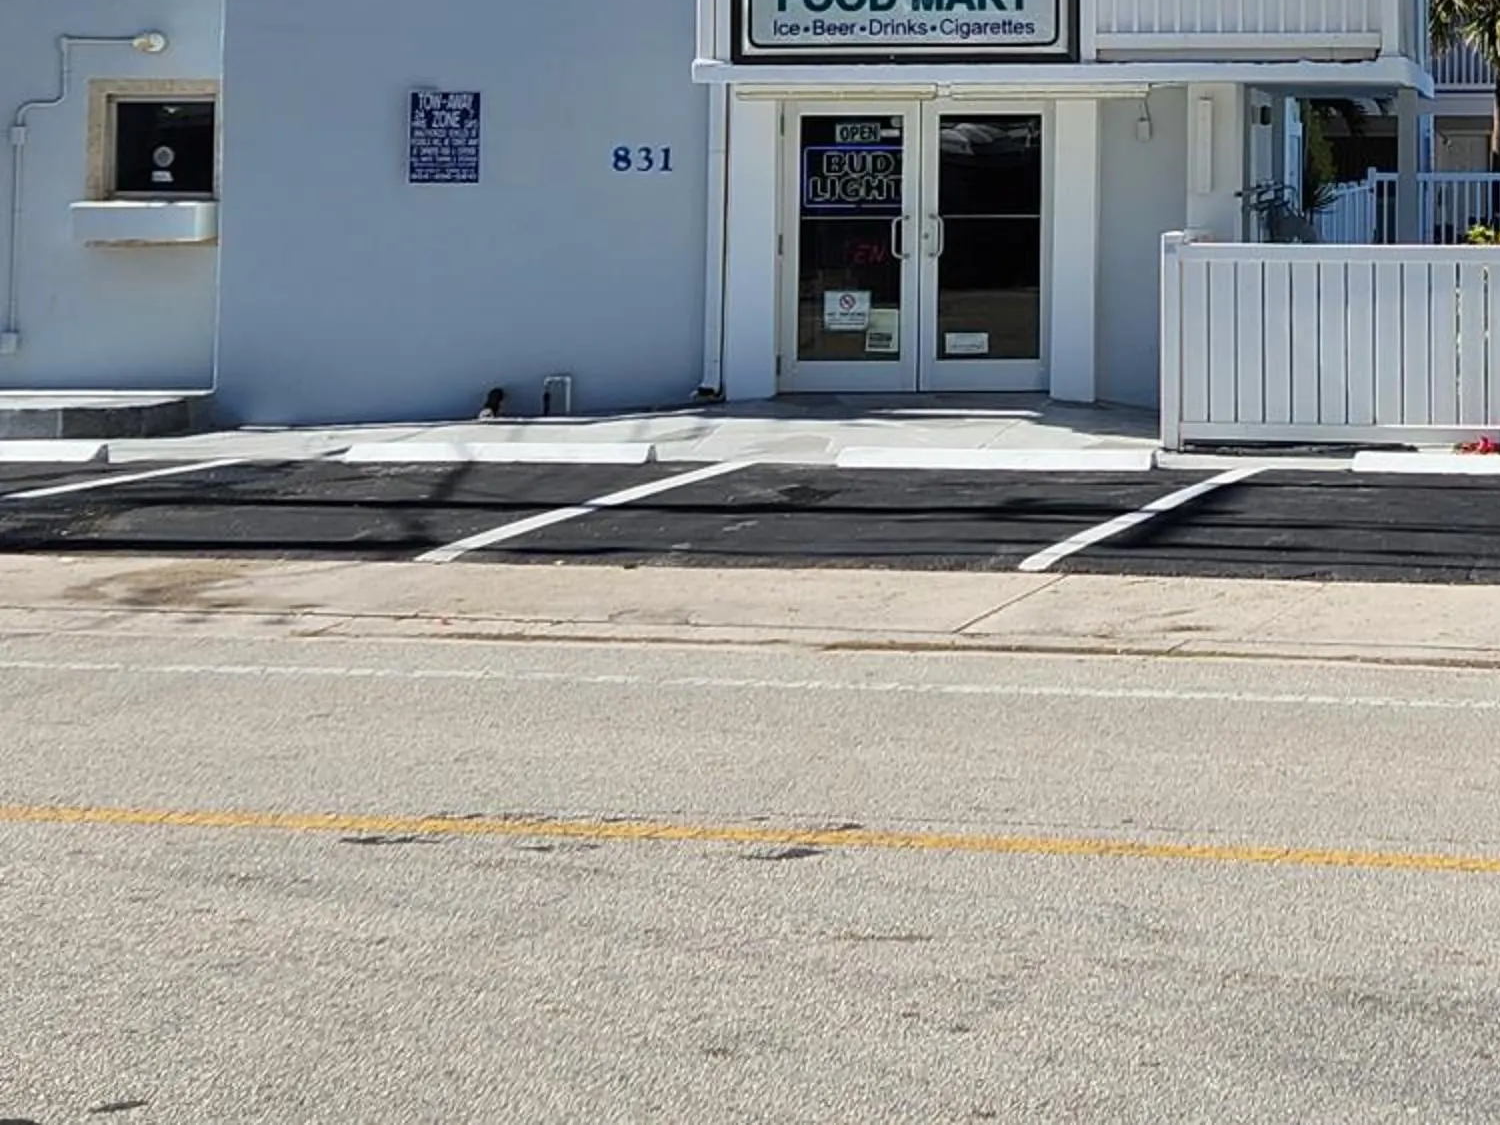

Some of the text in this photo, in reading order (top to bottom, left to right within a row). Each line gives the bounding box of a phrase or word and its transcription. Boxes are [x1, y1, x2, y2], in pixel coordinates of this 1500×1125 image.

[939, 18, 1036, 40] Cigarettes
[431, 111, 461, 128] ZONE
[839, 124, 878, 141] OPEN
[612, 146, 673, 172] 831
[823, 151, 895, 177] BUD
